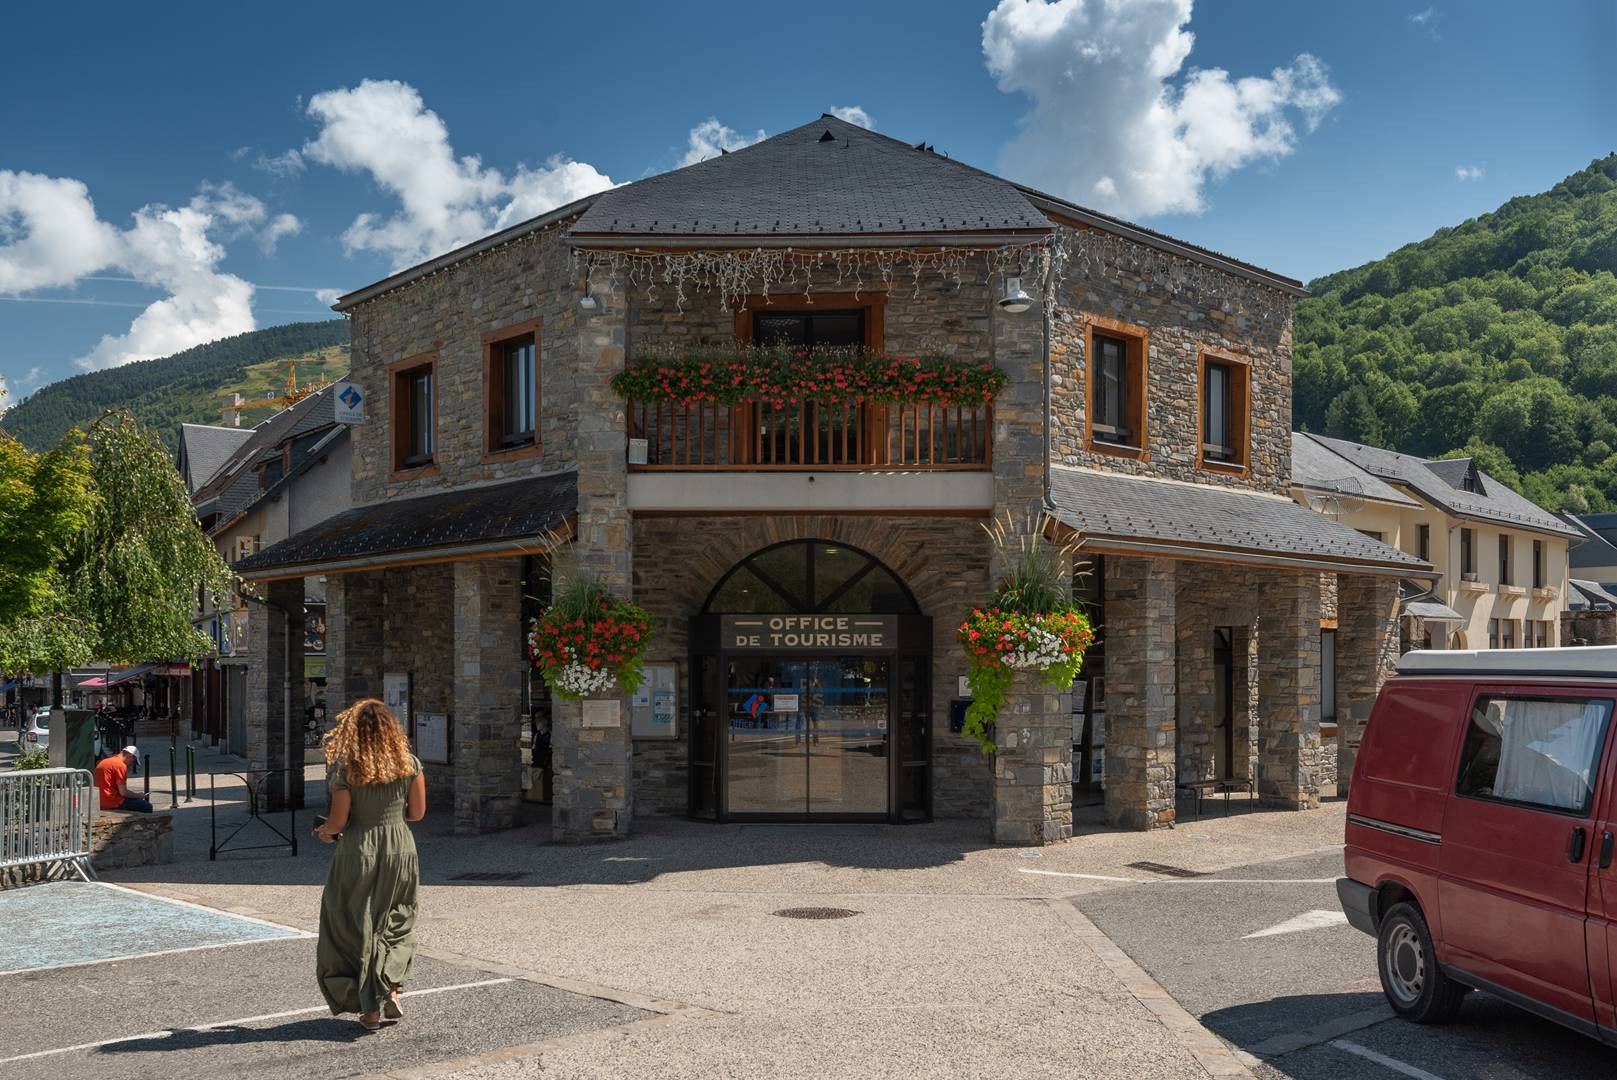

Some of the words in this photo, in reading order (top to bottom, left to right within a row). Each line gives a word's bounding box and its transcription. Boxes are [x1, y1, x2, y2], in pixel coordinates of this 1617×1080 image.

[769, 617, 849, 630] OFFICE
[735, 635, 761, 646] DE
[770, 633, 883, 646] TOURISME
